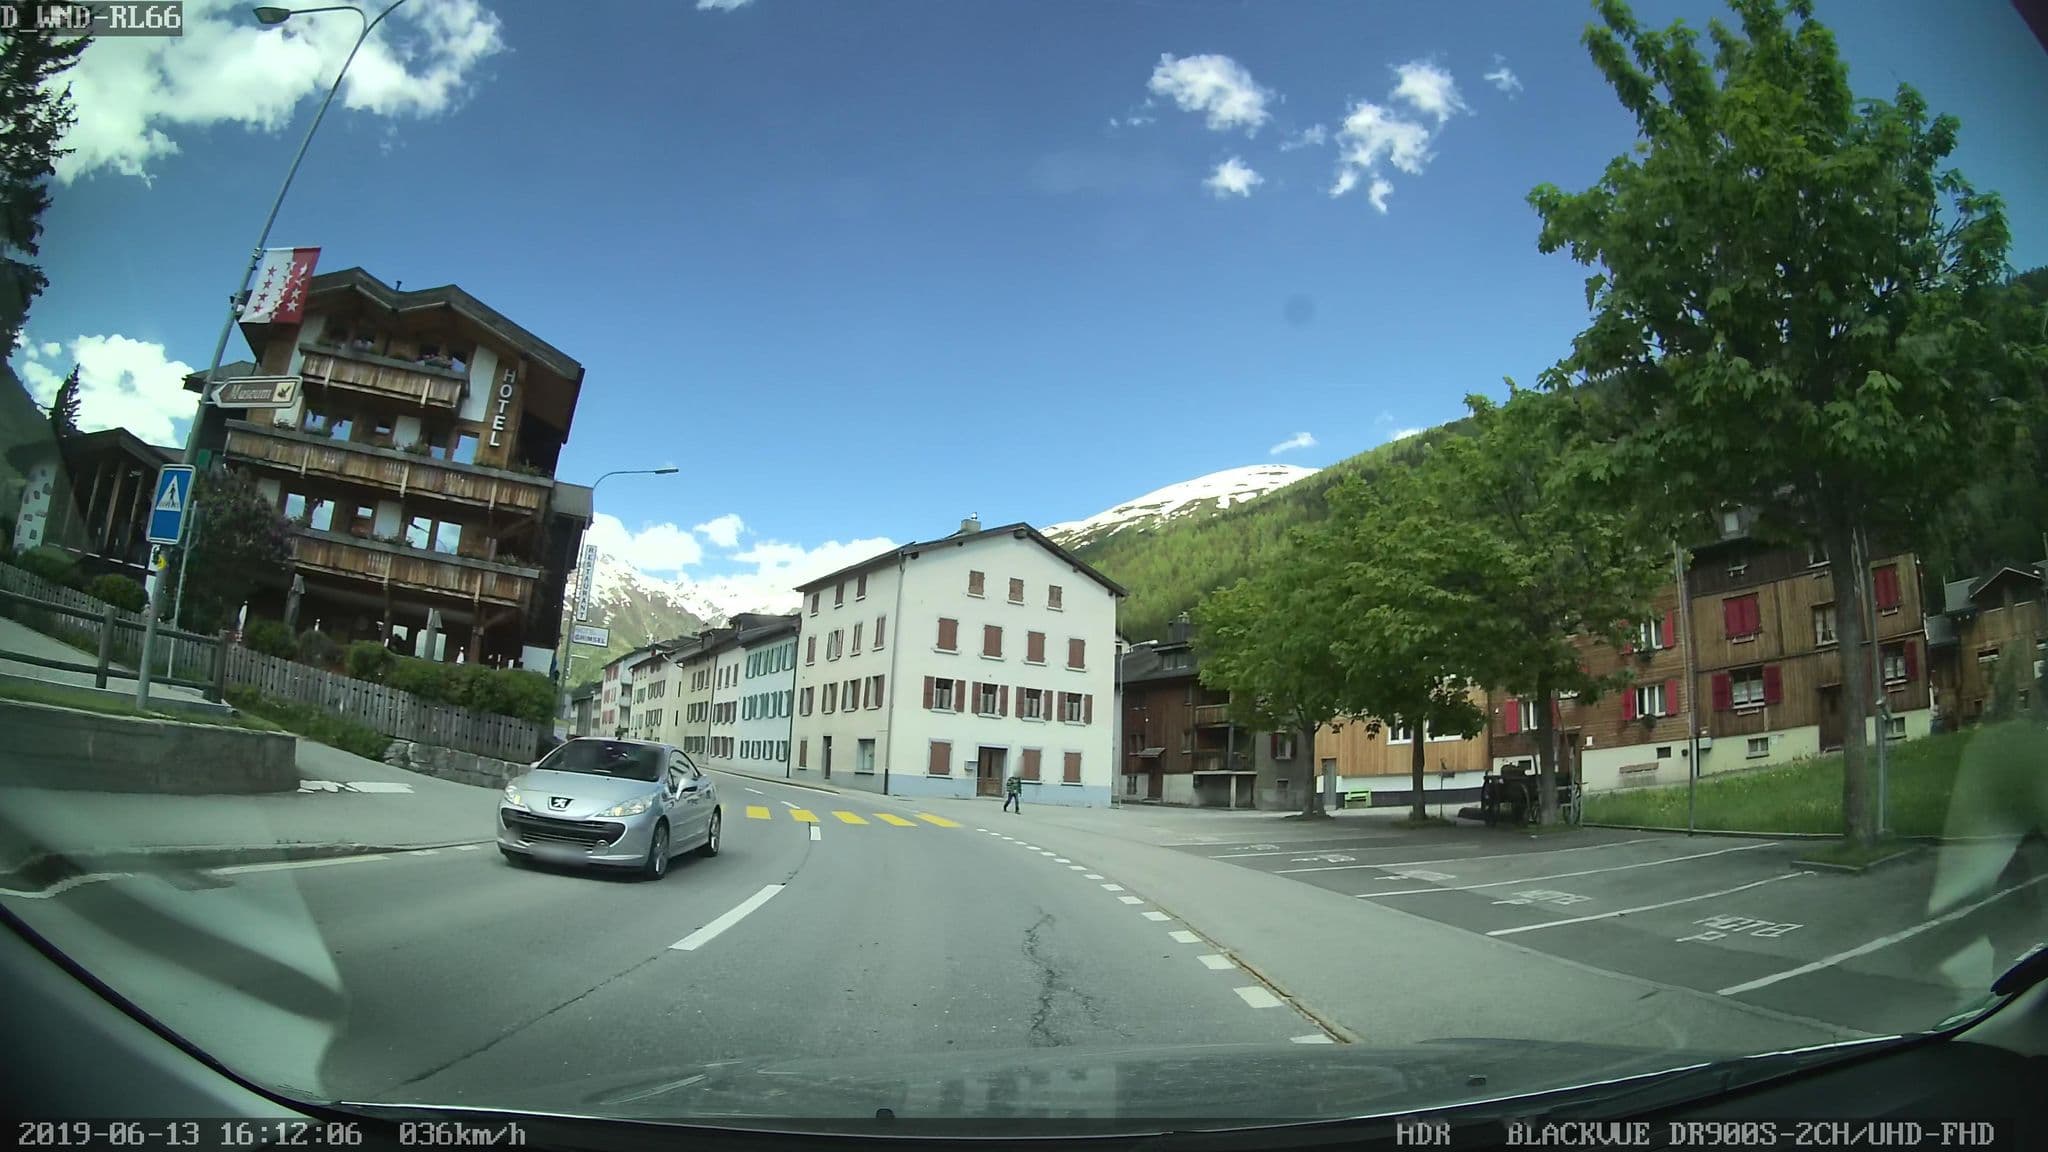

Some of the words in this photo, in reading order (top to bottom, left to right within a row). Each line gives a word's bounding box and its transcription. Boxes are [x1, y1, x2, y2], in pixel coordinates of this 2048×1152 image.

[231, 384, 272, 400] Museum
[489, 368, 517, 447] HOTEL
[579, 547, 595, 619] RESTAURANT
